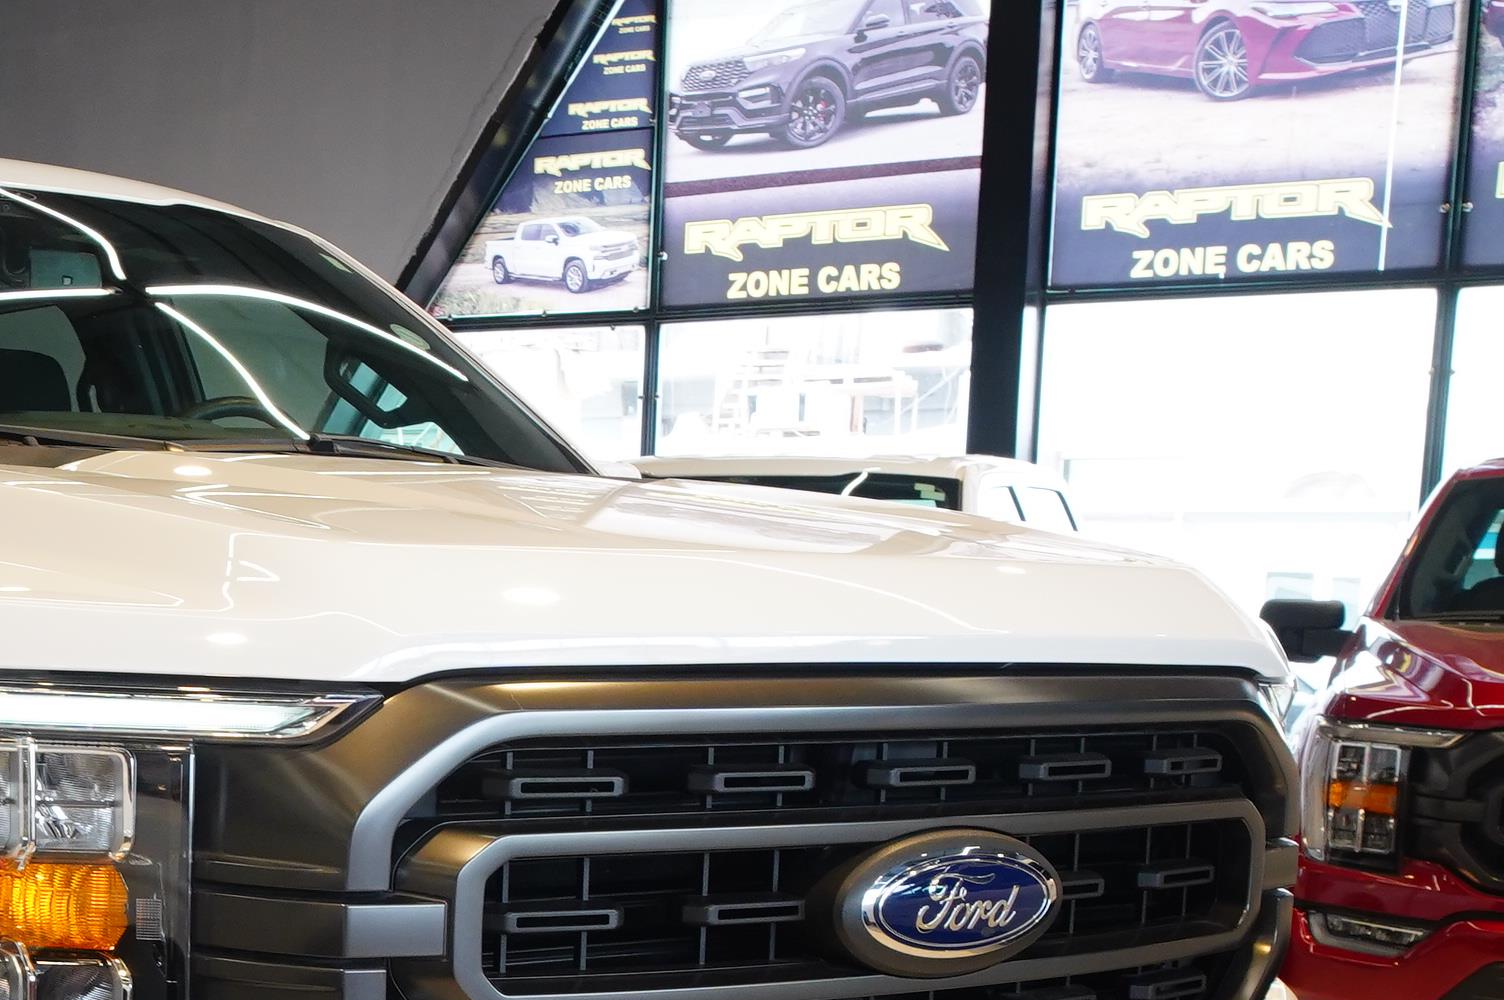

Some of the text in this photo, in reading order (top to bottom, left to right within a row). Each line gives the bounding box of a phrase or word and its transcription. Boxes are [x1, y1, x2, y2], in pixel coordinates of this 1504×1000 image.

[593, 50, 656, 65] RAPTOR
[603, 64, 646, 75] ZONE CARS
[568, 98, 652, 118] RAPTOR
[582, 117, 638, 130] ZONE CARS
[534, 148, 652, 177] RAPTOR
[554, 175, 632, 194] ZONE CARS
[1081, 177, 1393, 239] RAPTOR
[684, 203, 950, 262] RAPTOR
[1130, 240, 1335, 279] ZONE CARS
[727, 262, 901, 299] ZONE CARS
[915, 872, 1020, 933] Ford
